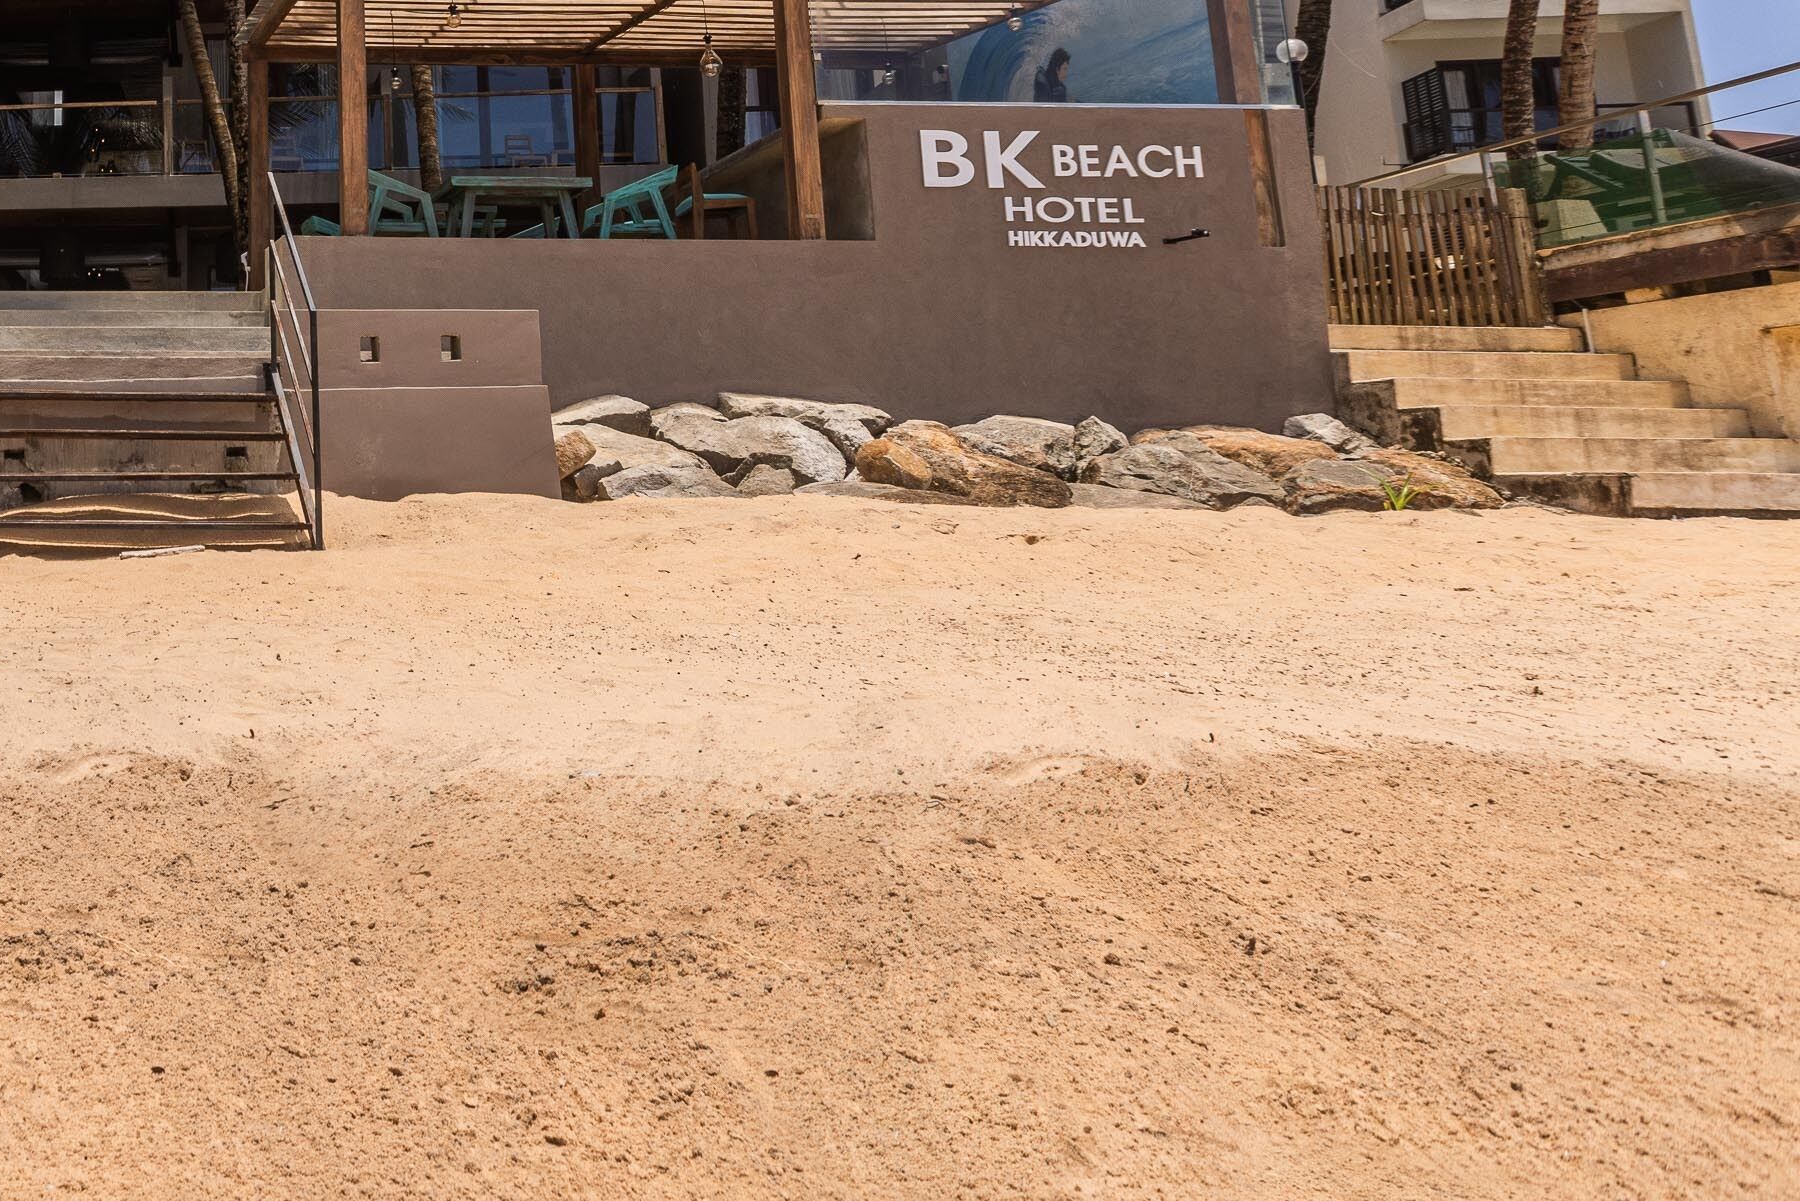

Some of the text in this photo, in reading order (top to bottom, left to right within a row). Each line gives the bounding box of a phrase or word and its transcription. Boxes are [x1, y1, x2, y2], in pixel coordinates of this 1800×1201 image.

[919, 129, 1204, 189] BK BEACH
[1004, 196, 1145, 223] HOTEL
[1008, 230, 1147, 248] HIKKADUWA
